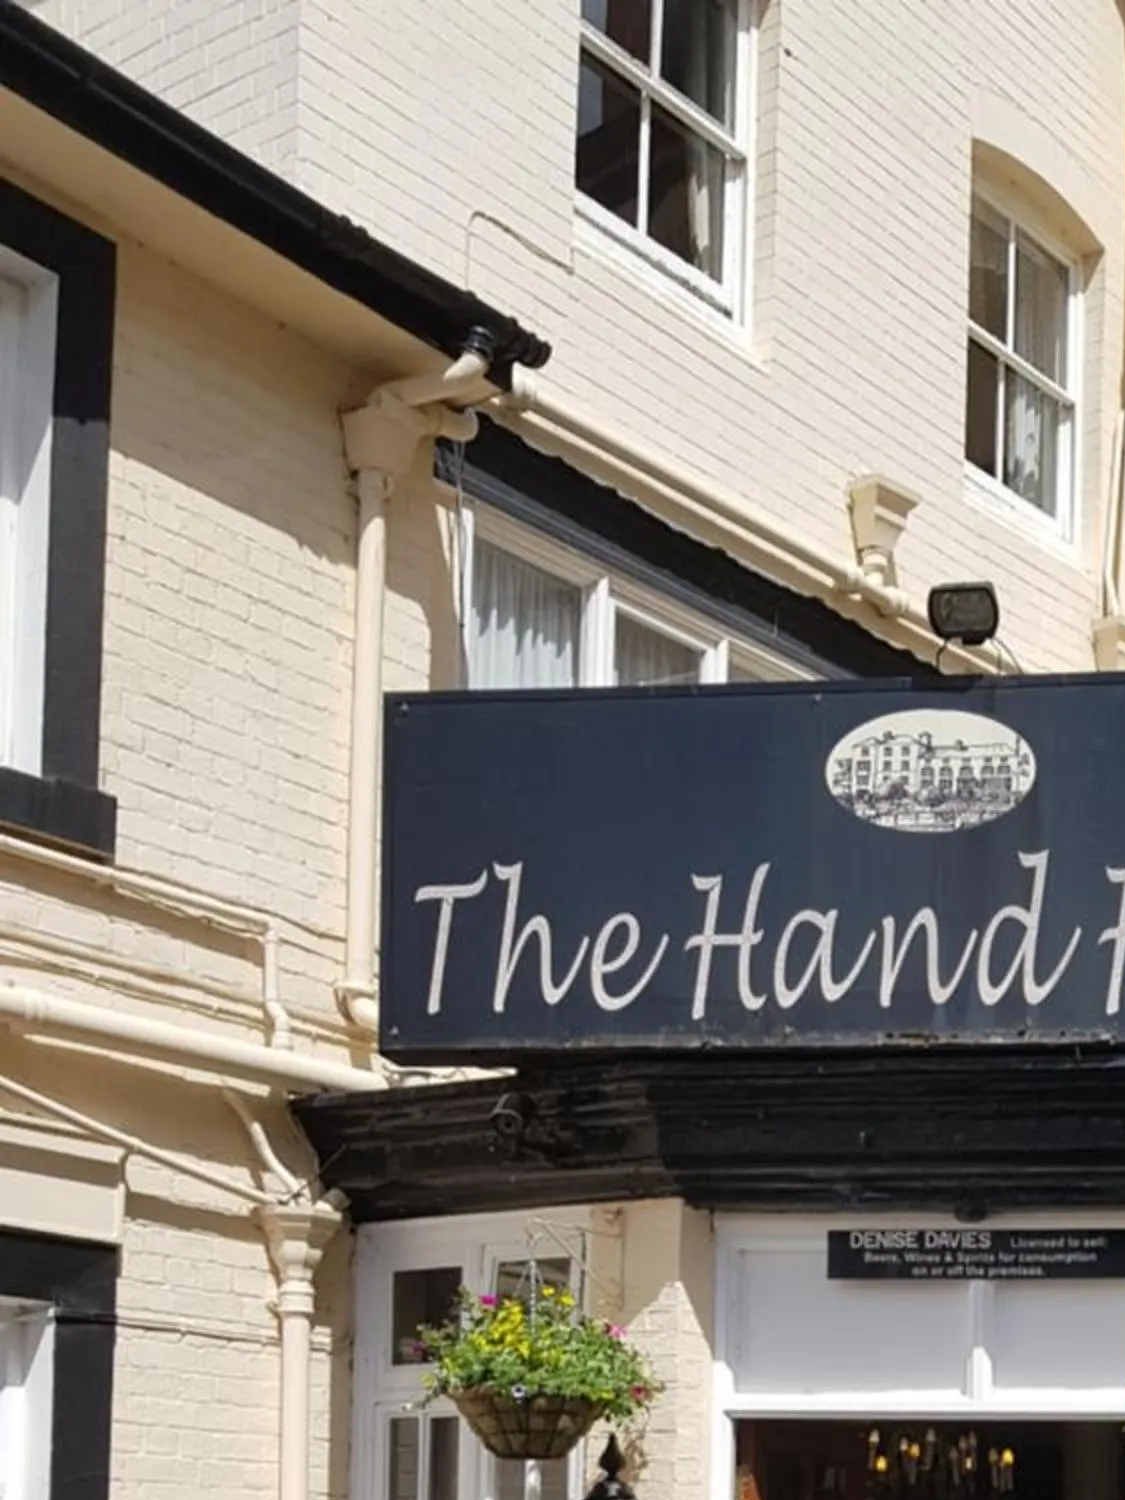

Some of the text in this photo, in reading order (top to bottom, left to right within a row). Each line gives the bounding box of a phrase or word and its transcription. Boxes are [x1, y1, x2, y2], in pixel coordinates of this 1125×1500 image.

[414, 860, 669, 1015] The
[684, 848, 1081, 1020] Hand
[850, 1231, 919, 1249] DENISE
[924, 1231, 992, 1249] DAVIES
[1010, 1236, 1065, 1248] Licensed
[1067, 1236, 1080, 1248] to
[904, 1252, 941, 1264] Wines
[944, 1253, 954, 1263] &
[998, 1251, 1016, 1263] for
[1018, 1251, 1098, 1265] consumption
[912, 1266, 928, 1276] on
[930, 1266, 944, 1276] or
[946, 1265, 963, 1276] off
[966, 1265, 985, 1276] the
